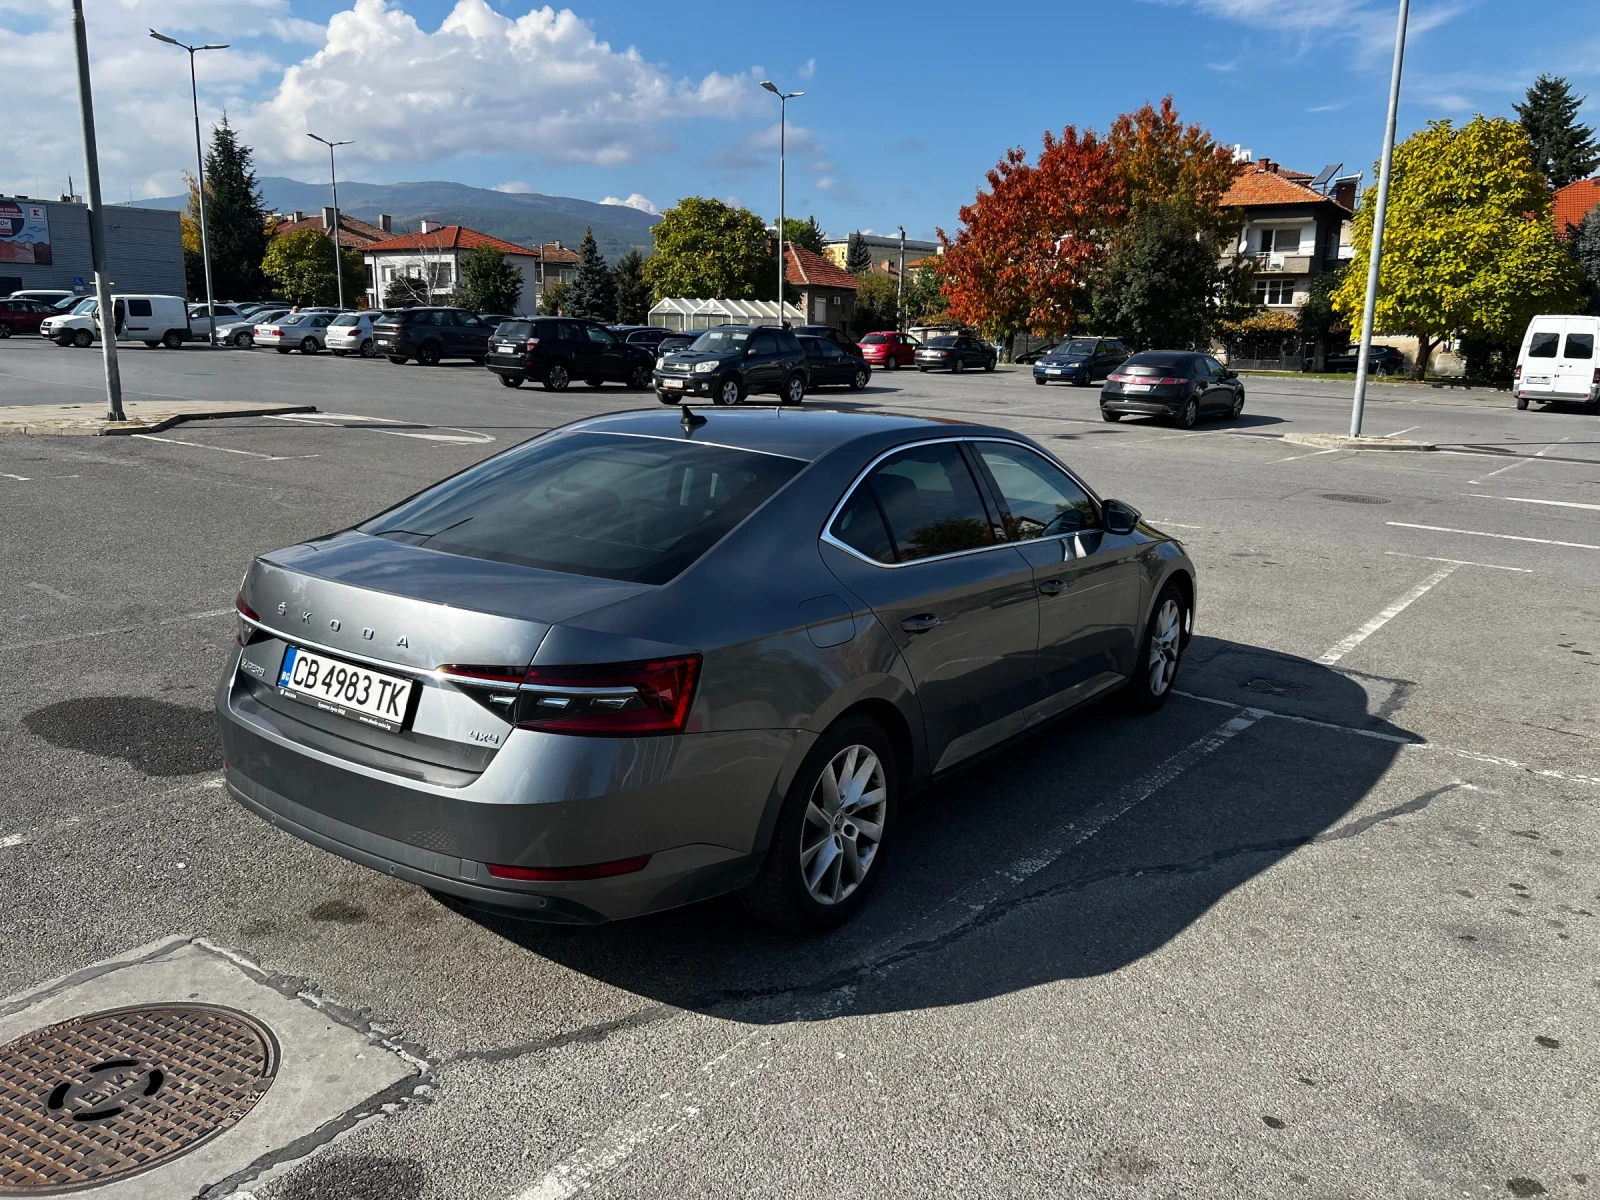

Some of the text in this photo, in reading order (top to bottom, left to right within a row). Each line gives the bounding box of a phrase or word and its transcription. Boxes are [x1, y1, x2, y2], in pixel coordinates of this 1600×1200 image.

[277, 601, 409, 648] ŠKODA
[281, 670, 290, 681] BG
[293, 656, 406, 716] CB 4983 TK
[109, 1082, 221, 1150] ИХТИМАН
